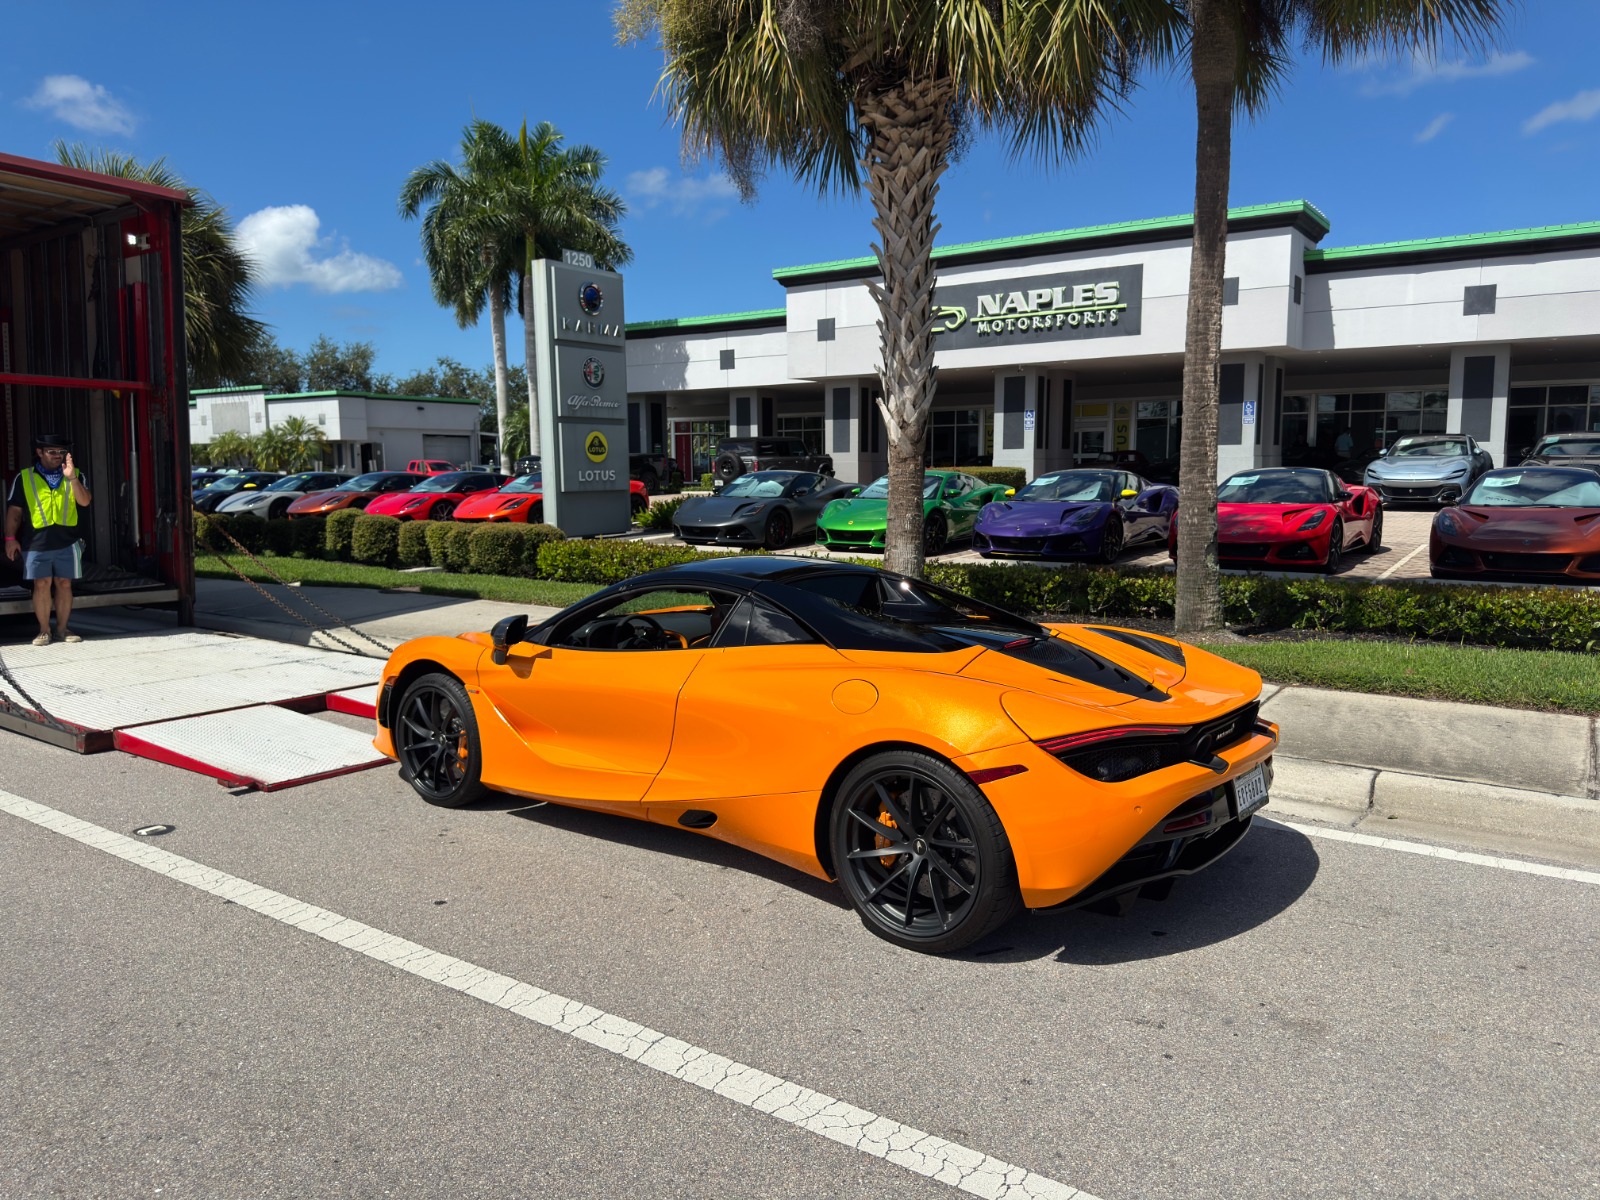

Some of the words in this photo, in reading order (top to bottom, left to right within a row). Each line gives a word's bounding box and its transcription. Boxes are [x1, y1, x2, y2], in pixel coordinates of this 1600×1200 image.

[565, 251, 592, 268] 1250
[976, 281, 1120, 317] NAPLES
[977, 309, 1119, 333] MOTORSPORTS
[567, 394, 591, 410] Alfa
[590, 395, 620, 408] Romeo
[578, 470, 616, 481] LOTUS
